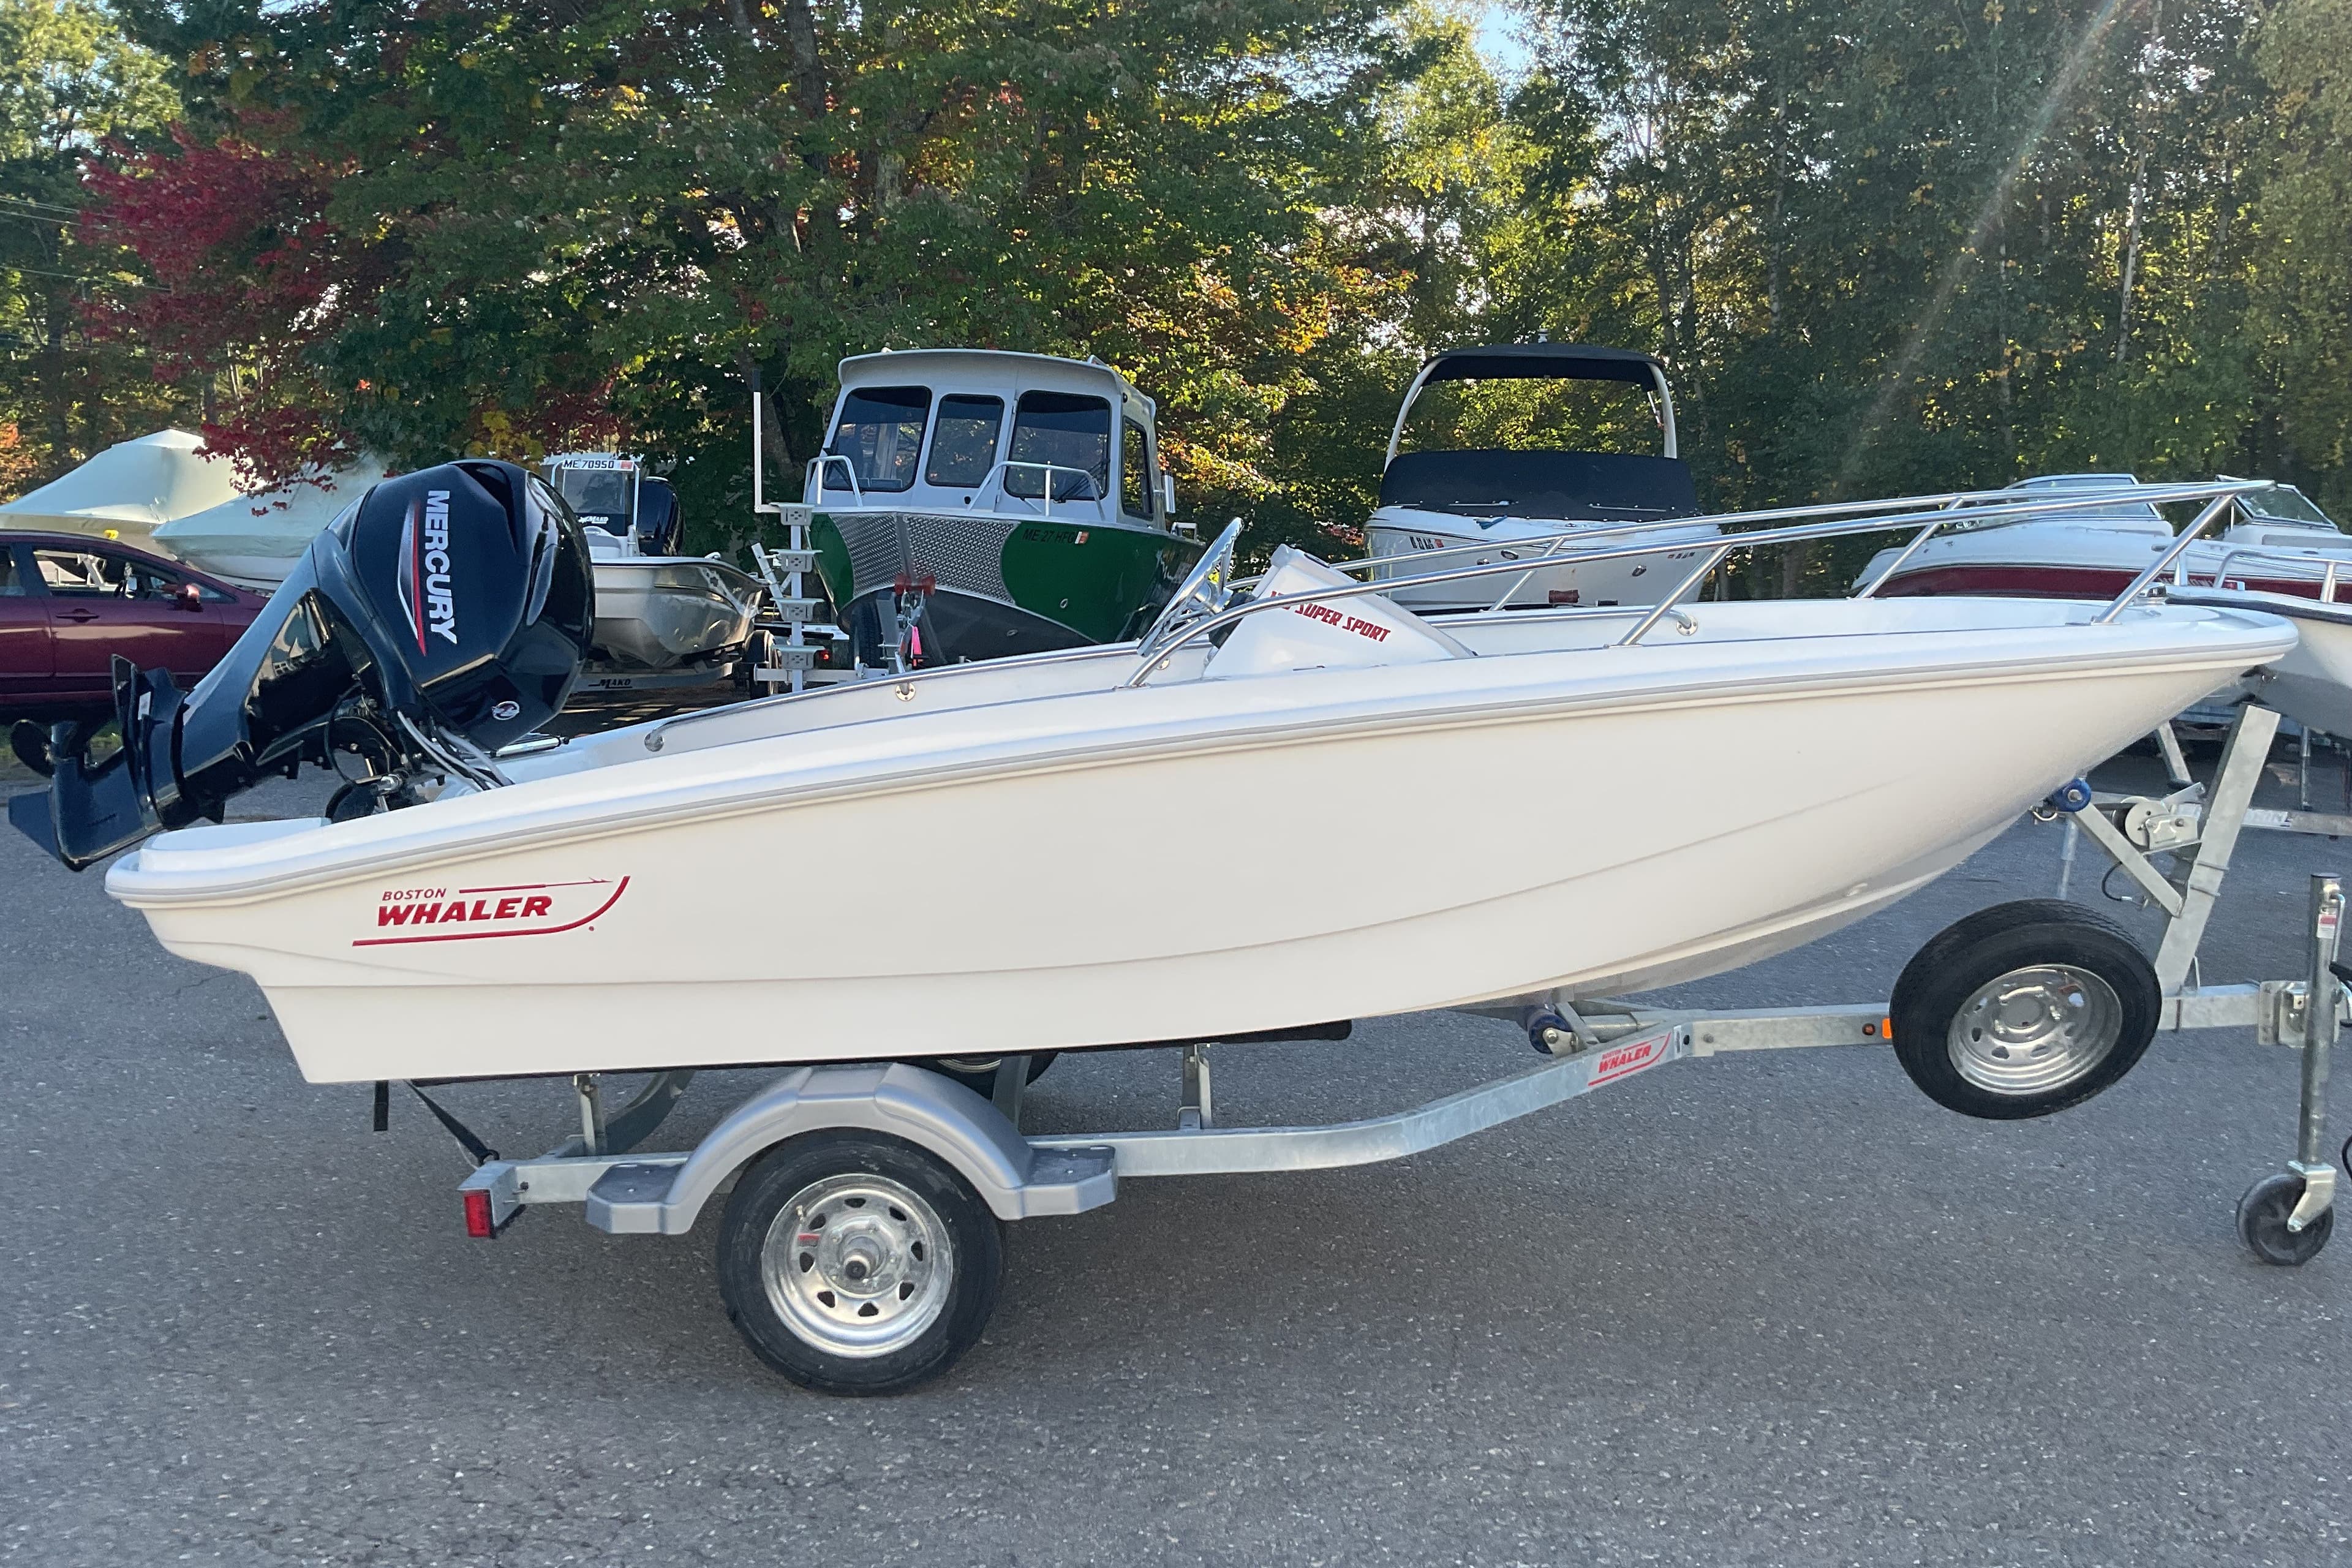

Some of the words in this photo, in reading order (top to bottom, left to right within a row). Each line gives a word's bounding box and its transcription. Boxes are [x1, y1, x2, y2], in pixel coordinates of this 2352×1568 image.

[564, 460, 579, 469] ME
[425, 491, 458, 644] MERCURY
[1294, 603, 1343, 626] SUPER
[1342, 616, 1391, 642] SPORT
[600, 678, 631, 688] MAKO
[382, 888, 447, 902] BOSTON
[378, 895, 552, 927] WHALER
[1599, 1044, 1652, 1073] WHALER
